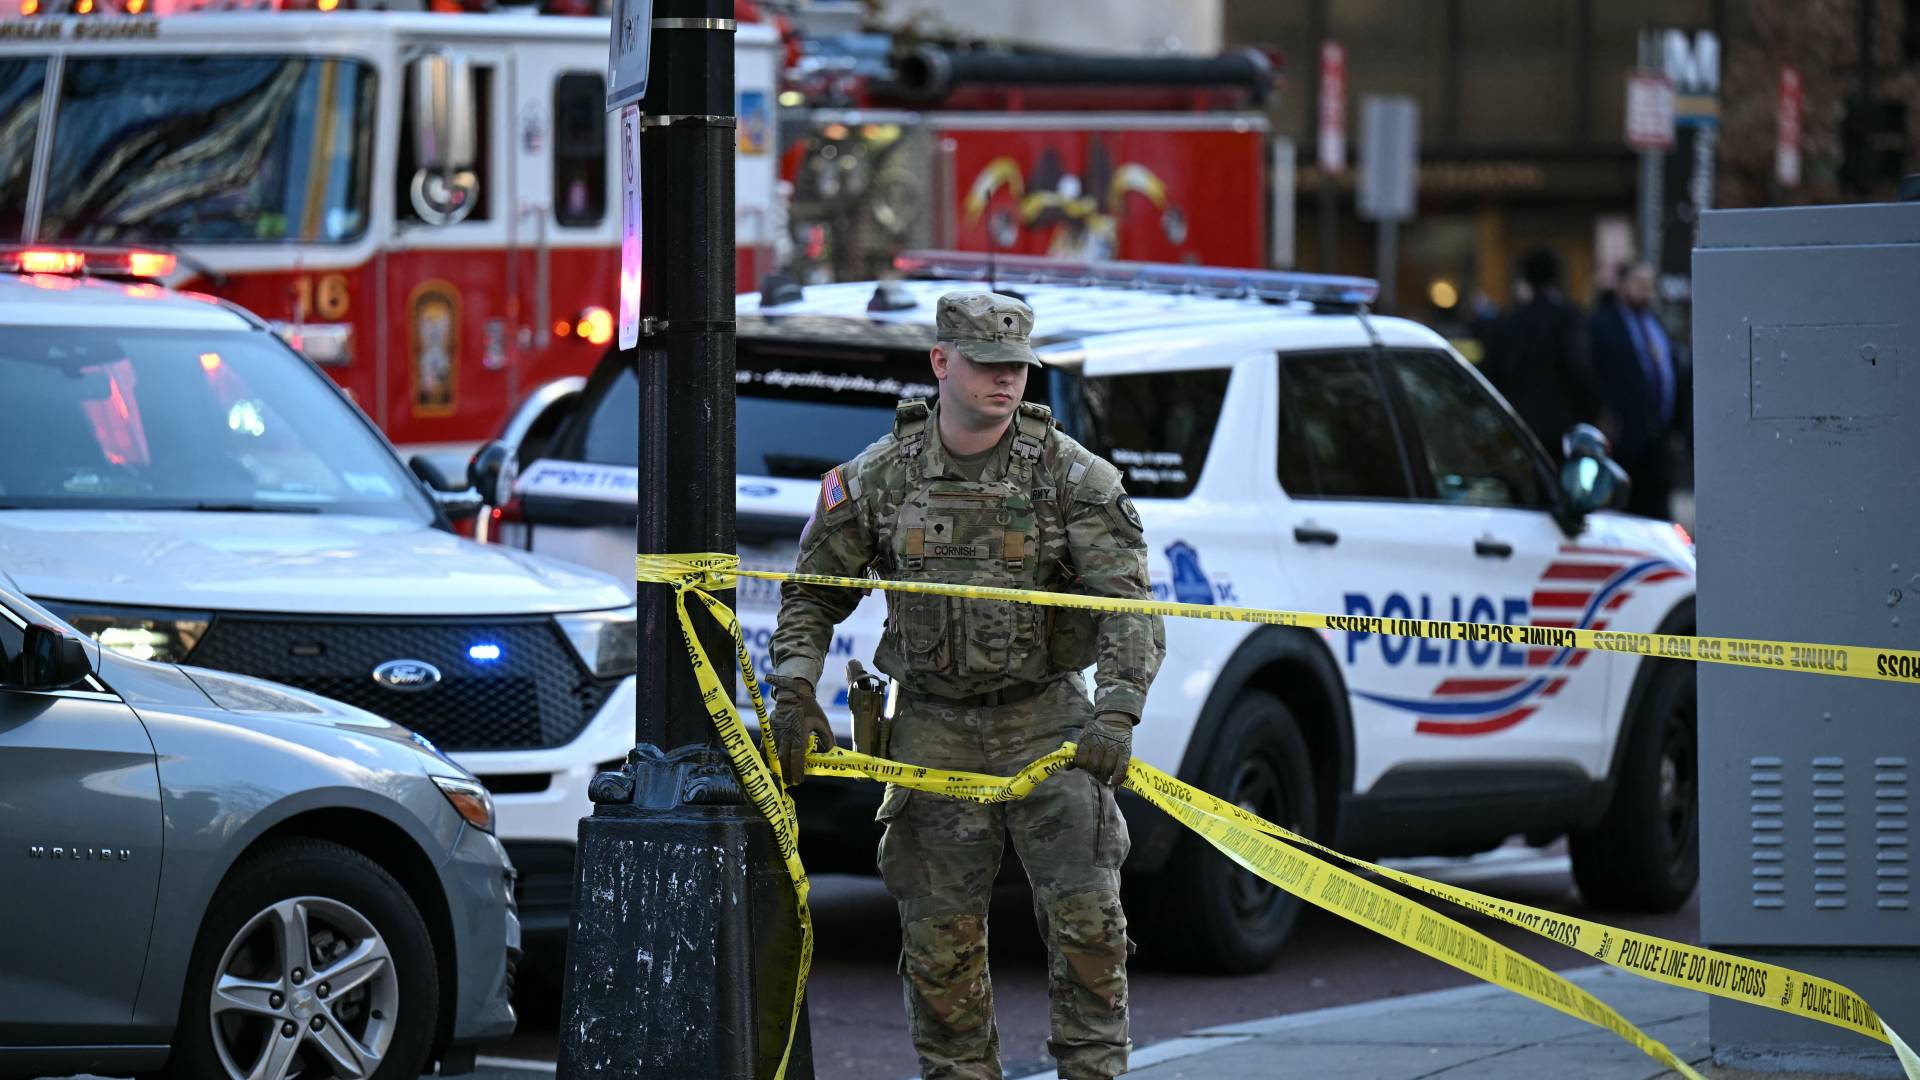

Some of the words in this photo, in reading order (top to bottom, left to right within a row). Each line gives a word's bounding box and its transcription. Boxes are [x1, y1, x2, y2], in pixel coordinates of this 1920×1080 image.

[291, 277, 350, 319] 16
[1032, 488, 1050, 500] RMY
[934, 545, 976, 557] CORNISH
[1343, 590, 1528, 669] POLICE
[1456, 621, 1513, 643] SCENE
[1519, 625, 1577, 648] CRIME
[1593, 631, 1651, 654] CROSS
[1656, 636, 1692, 658] NOT
[1697, 639, 1723, 660] DO
[1727, 641, 1785, 667] SCENE
[1789, 645, 1849, 671] CRIME
[1877, 653, 1920, 678] ROSS
[711, 708, 746, 751] POLICE
[732, 748, 760, 777] LINE
[745, 774, 769, 798] DO
[756, 792, 783, 824] NOT
[31, 846, 131, 861] MALIBU
[1617, 938, 1663, 972] POLICE
[1660, 948, 1689, 979] LINE
[1687, 954, 1706, 983] DO
[1706, 958, 1732, 989] NOT
[1731, 964, 1767, 998] CROSS
[1800, 981, 1831, 1016] POLICE
[1834, 991, 1850, 1021] LINE
[1852, 998, 1863, 1026] DO
